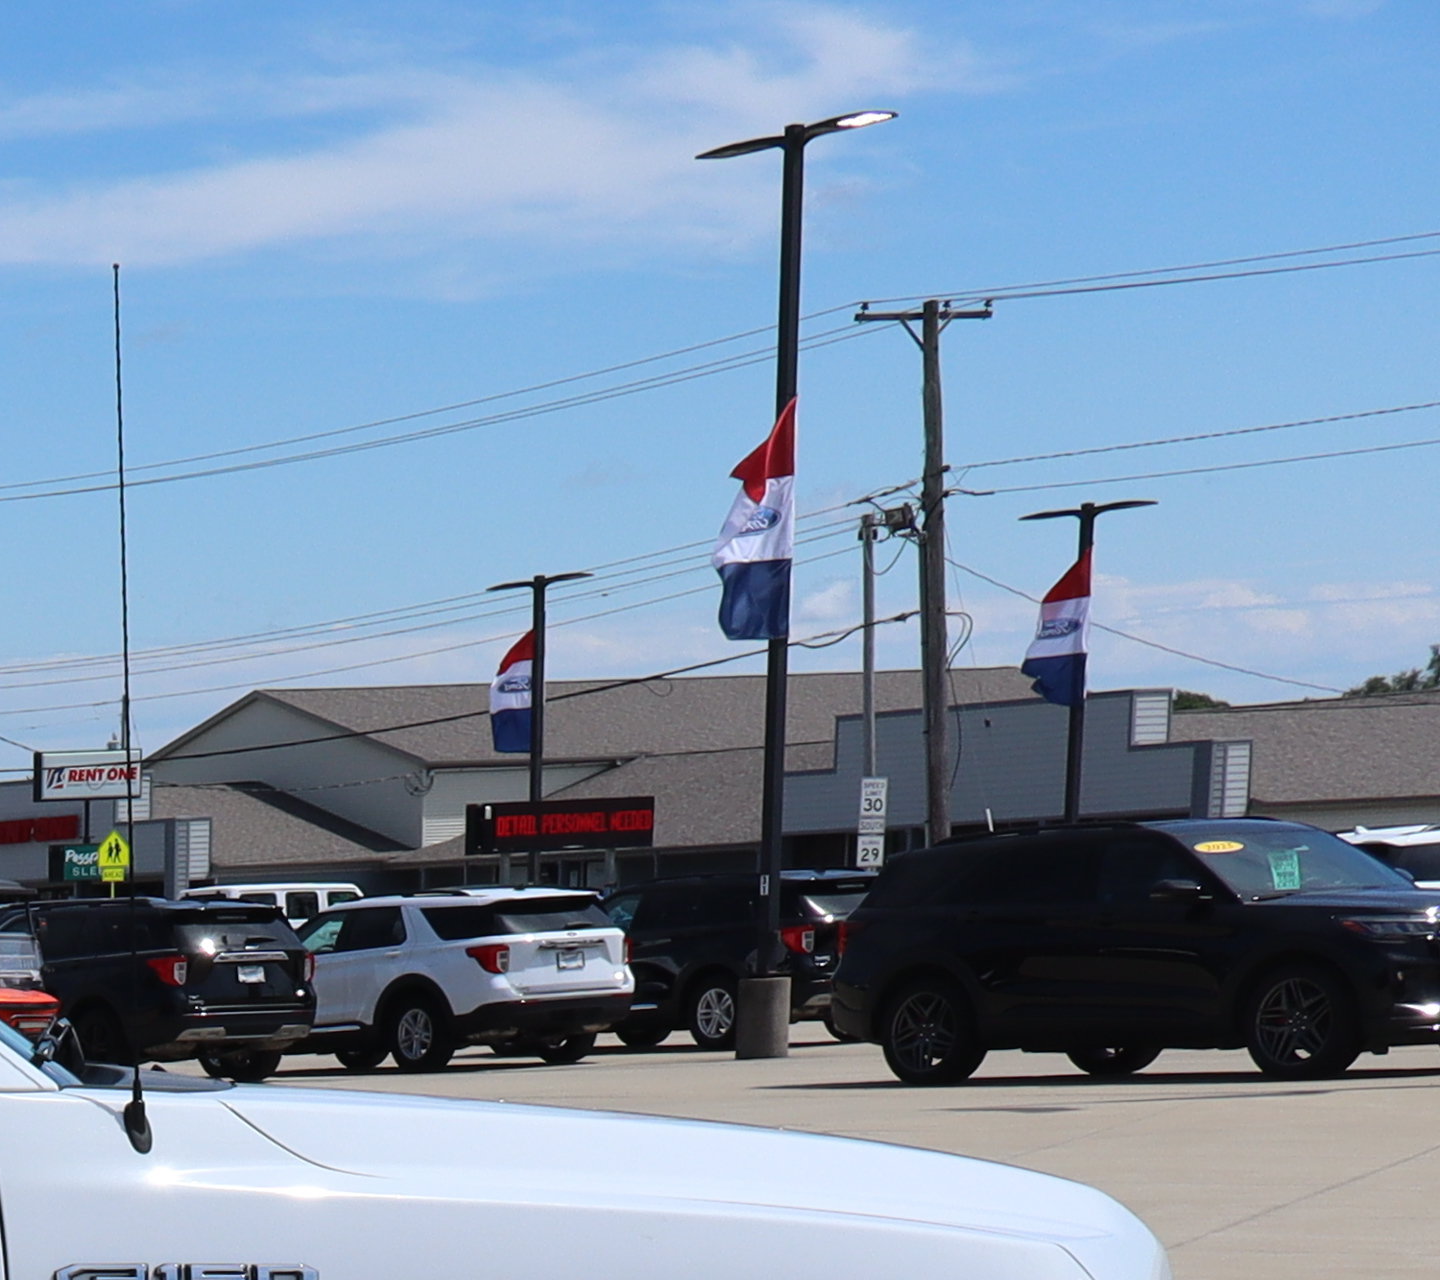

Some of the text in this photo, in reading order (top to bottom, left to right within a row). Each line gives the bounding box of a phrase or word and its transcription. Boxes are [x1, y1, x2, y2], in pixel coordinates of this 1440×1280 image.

[68, 766, 138, 782] RENT ONE
[863, 798, 883, 812] 30
[496, 810, 653, 837] DETAIL PERSONNEL NEEDED
[860, 848, 880, 862] 29
